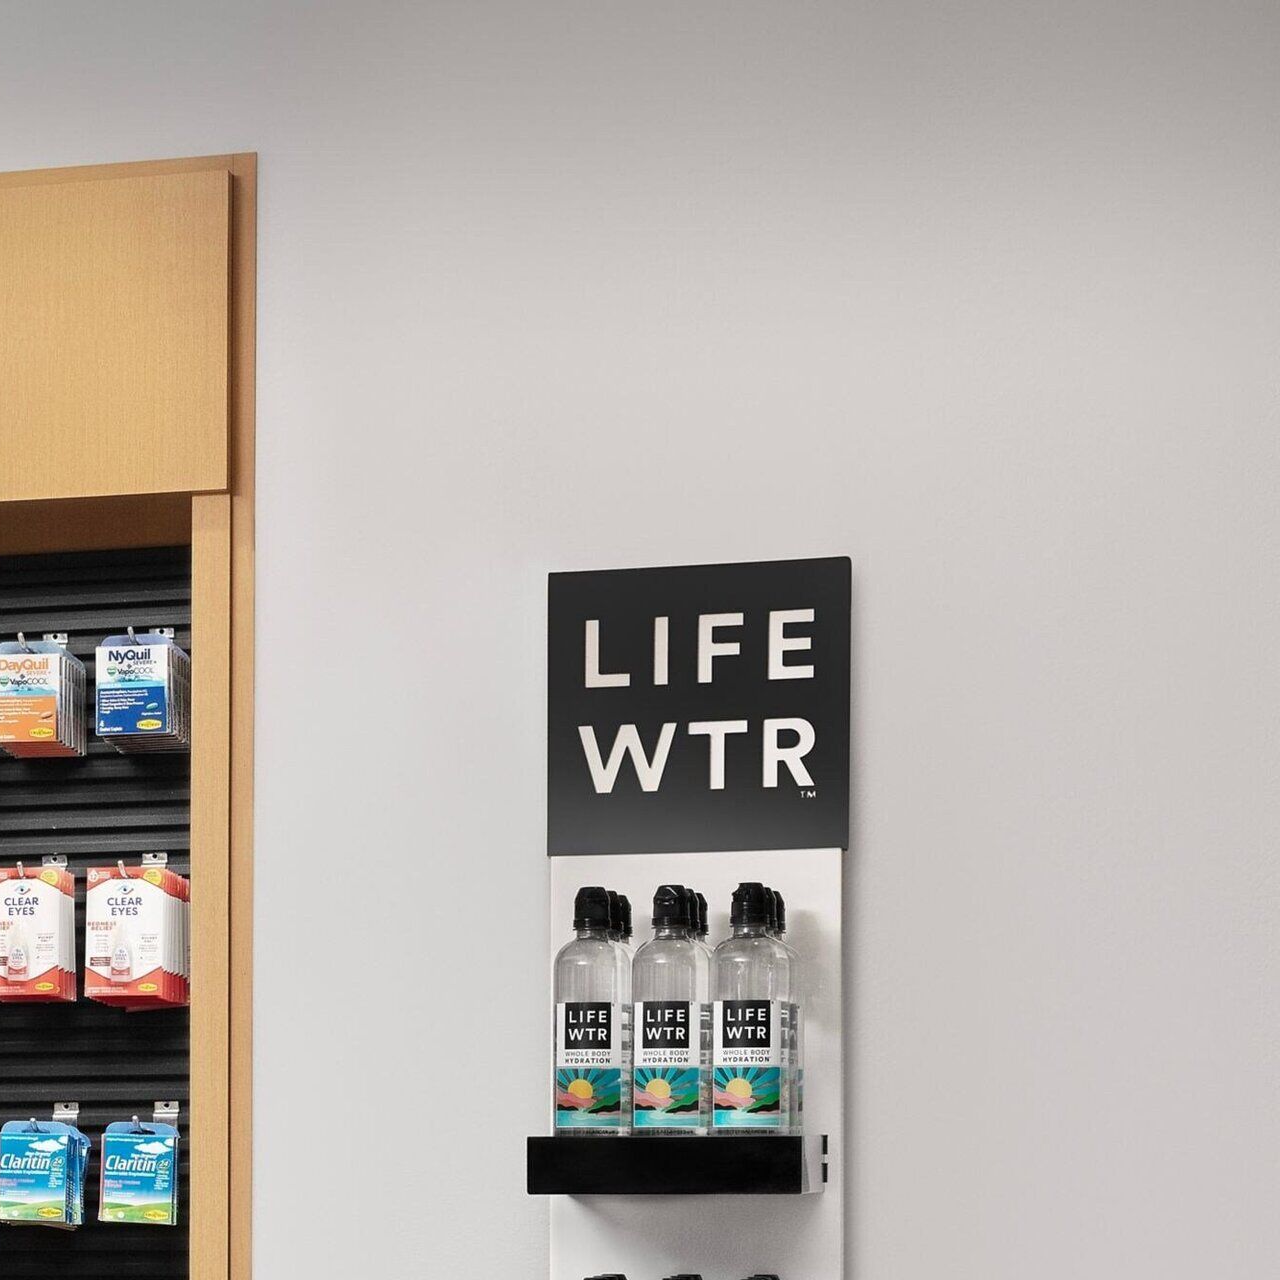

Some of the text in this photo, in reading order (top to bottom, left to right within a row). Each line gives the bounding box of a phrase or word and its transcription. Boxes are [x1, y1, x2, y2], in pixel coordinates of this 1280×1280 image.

[585, 608, 814, 688] LIFE
[109, 649, 151, 664] NyQuil
[117, 666, 154, 675] VapoCOOL
[10, 678, 48, 687] VapoCOOL
[577, 717, 816, 794] WTR
[4, 897, 39, 906] CLEAR
[107, 897, 143, 906] CLEAR
[8, 907, 35, 916] EYES
[111, 907, 139, 916] EYES
[569, 1010, 607, 1023] LIFE
[646, 1009, 685, 1023] LIFE
[727, 1008, 766, 1021] LIFE
[568, 1029, 608, 1041] WTR
[646, 1028, 685, 1041] WTR
[726, 1027, 766, 1040] WTR
[0, 1153, 51, 1170] Claritin
[105, 1155, 157, 1172] Claritin
